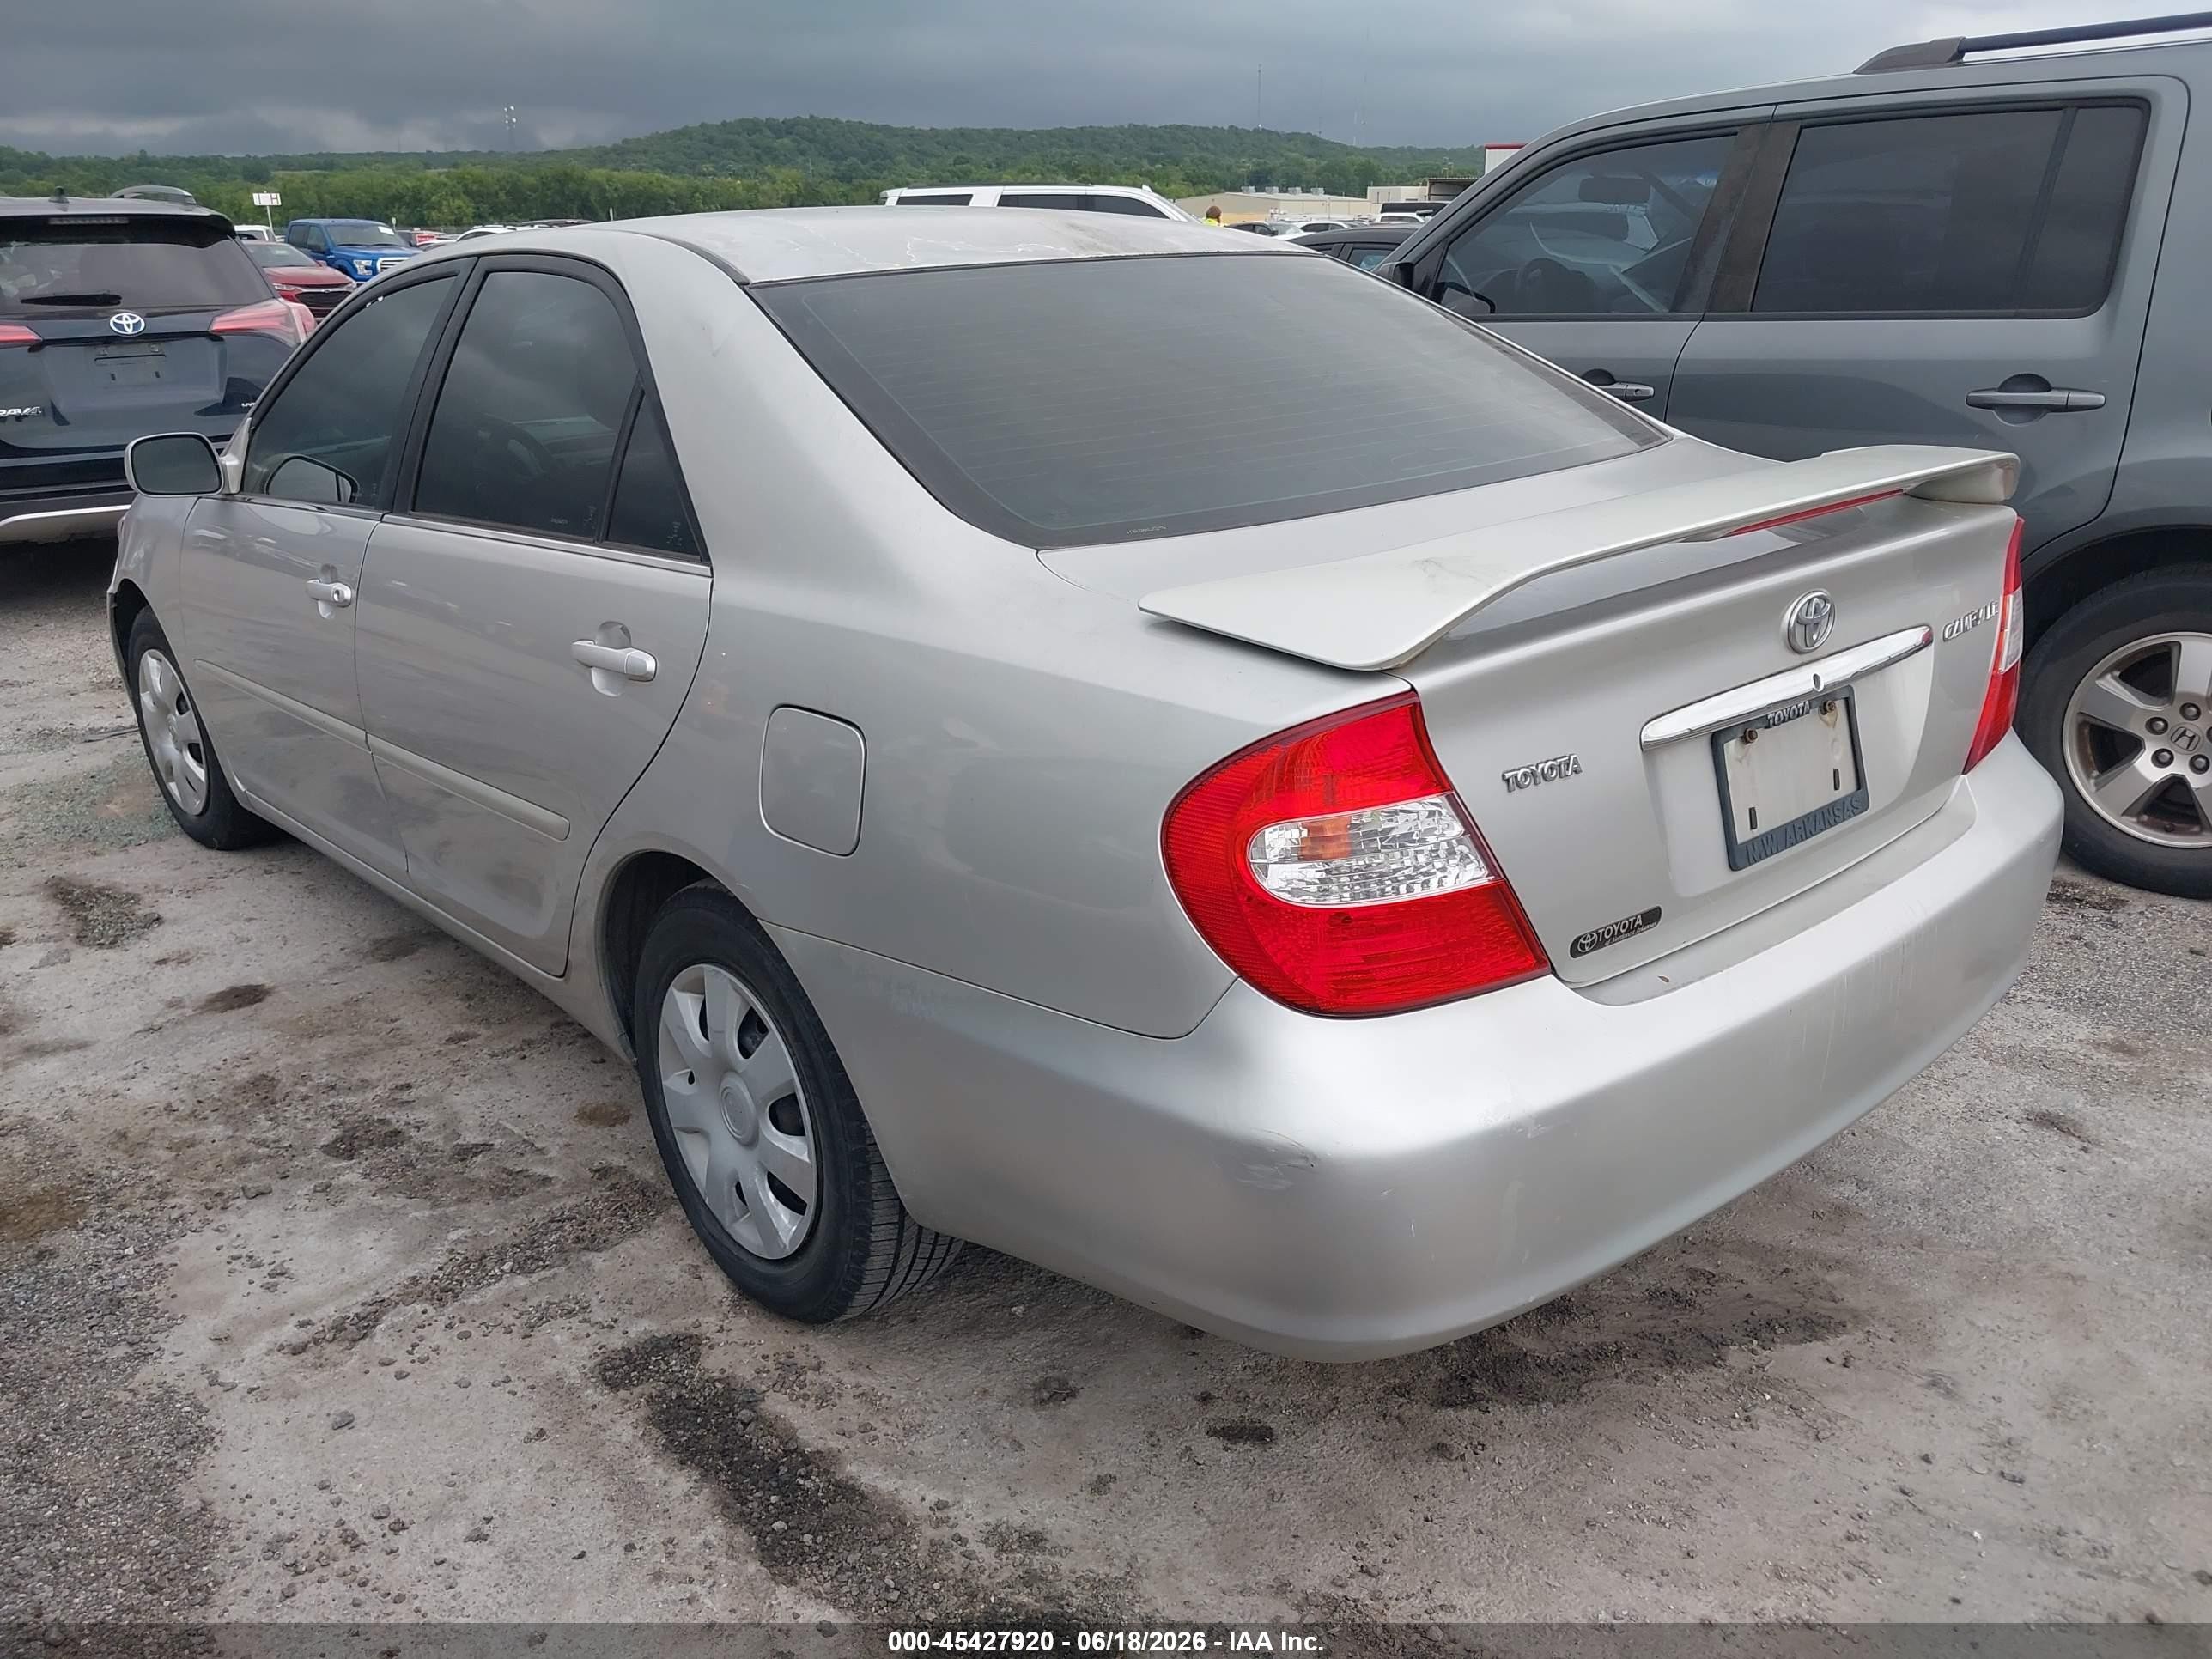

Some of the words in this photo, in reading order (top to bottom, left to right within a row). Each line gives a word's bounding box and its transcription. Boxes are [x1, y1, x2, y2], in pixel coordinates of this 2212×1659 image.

[1767, 700, 1811, 728] TOYOTA
[1502, 754, 1583, 793] TOYOTA
[1784, 795, 1862, 851] ARKANSAS
[1597, 915, 1643, 942] TOYOTA
